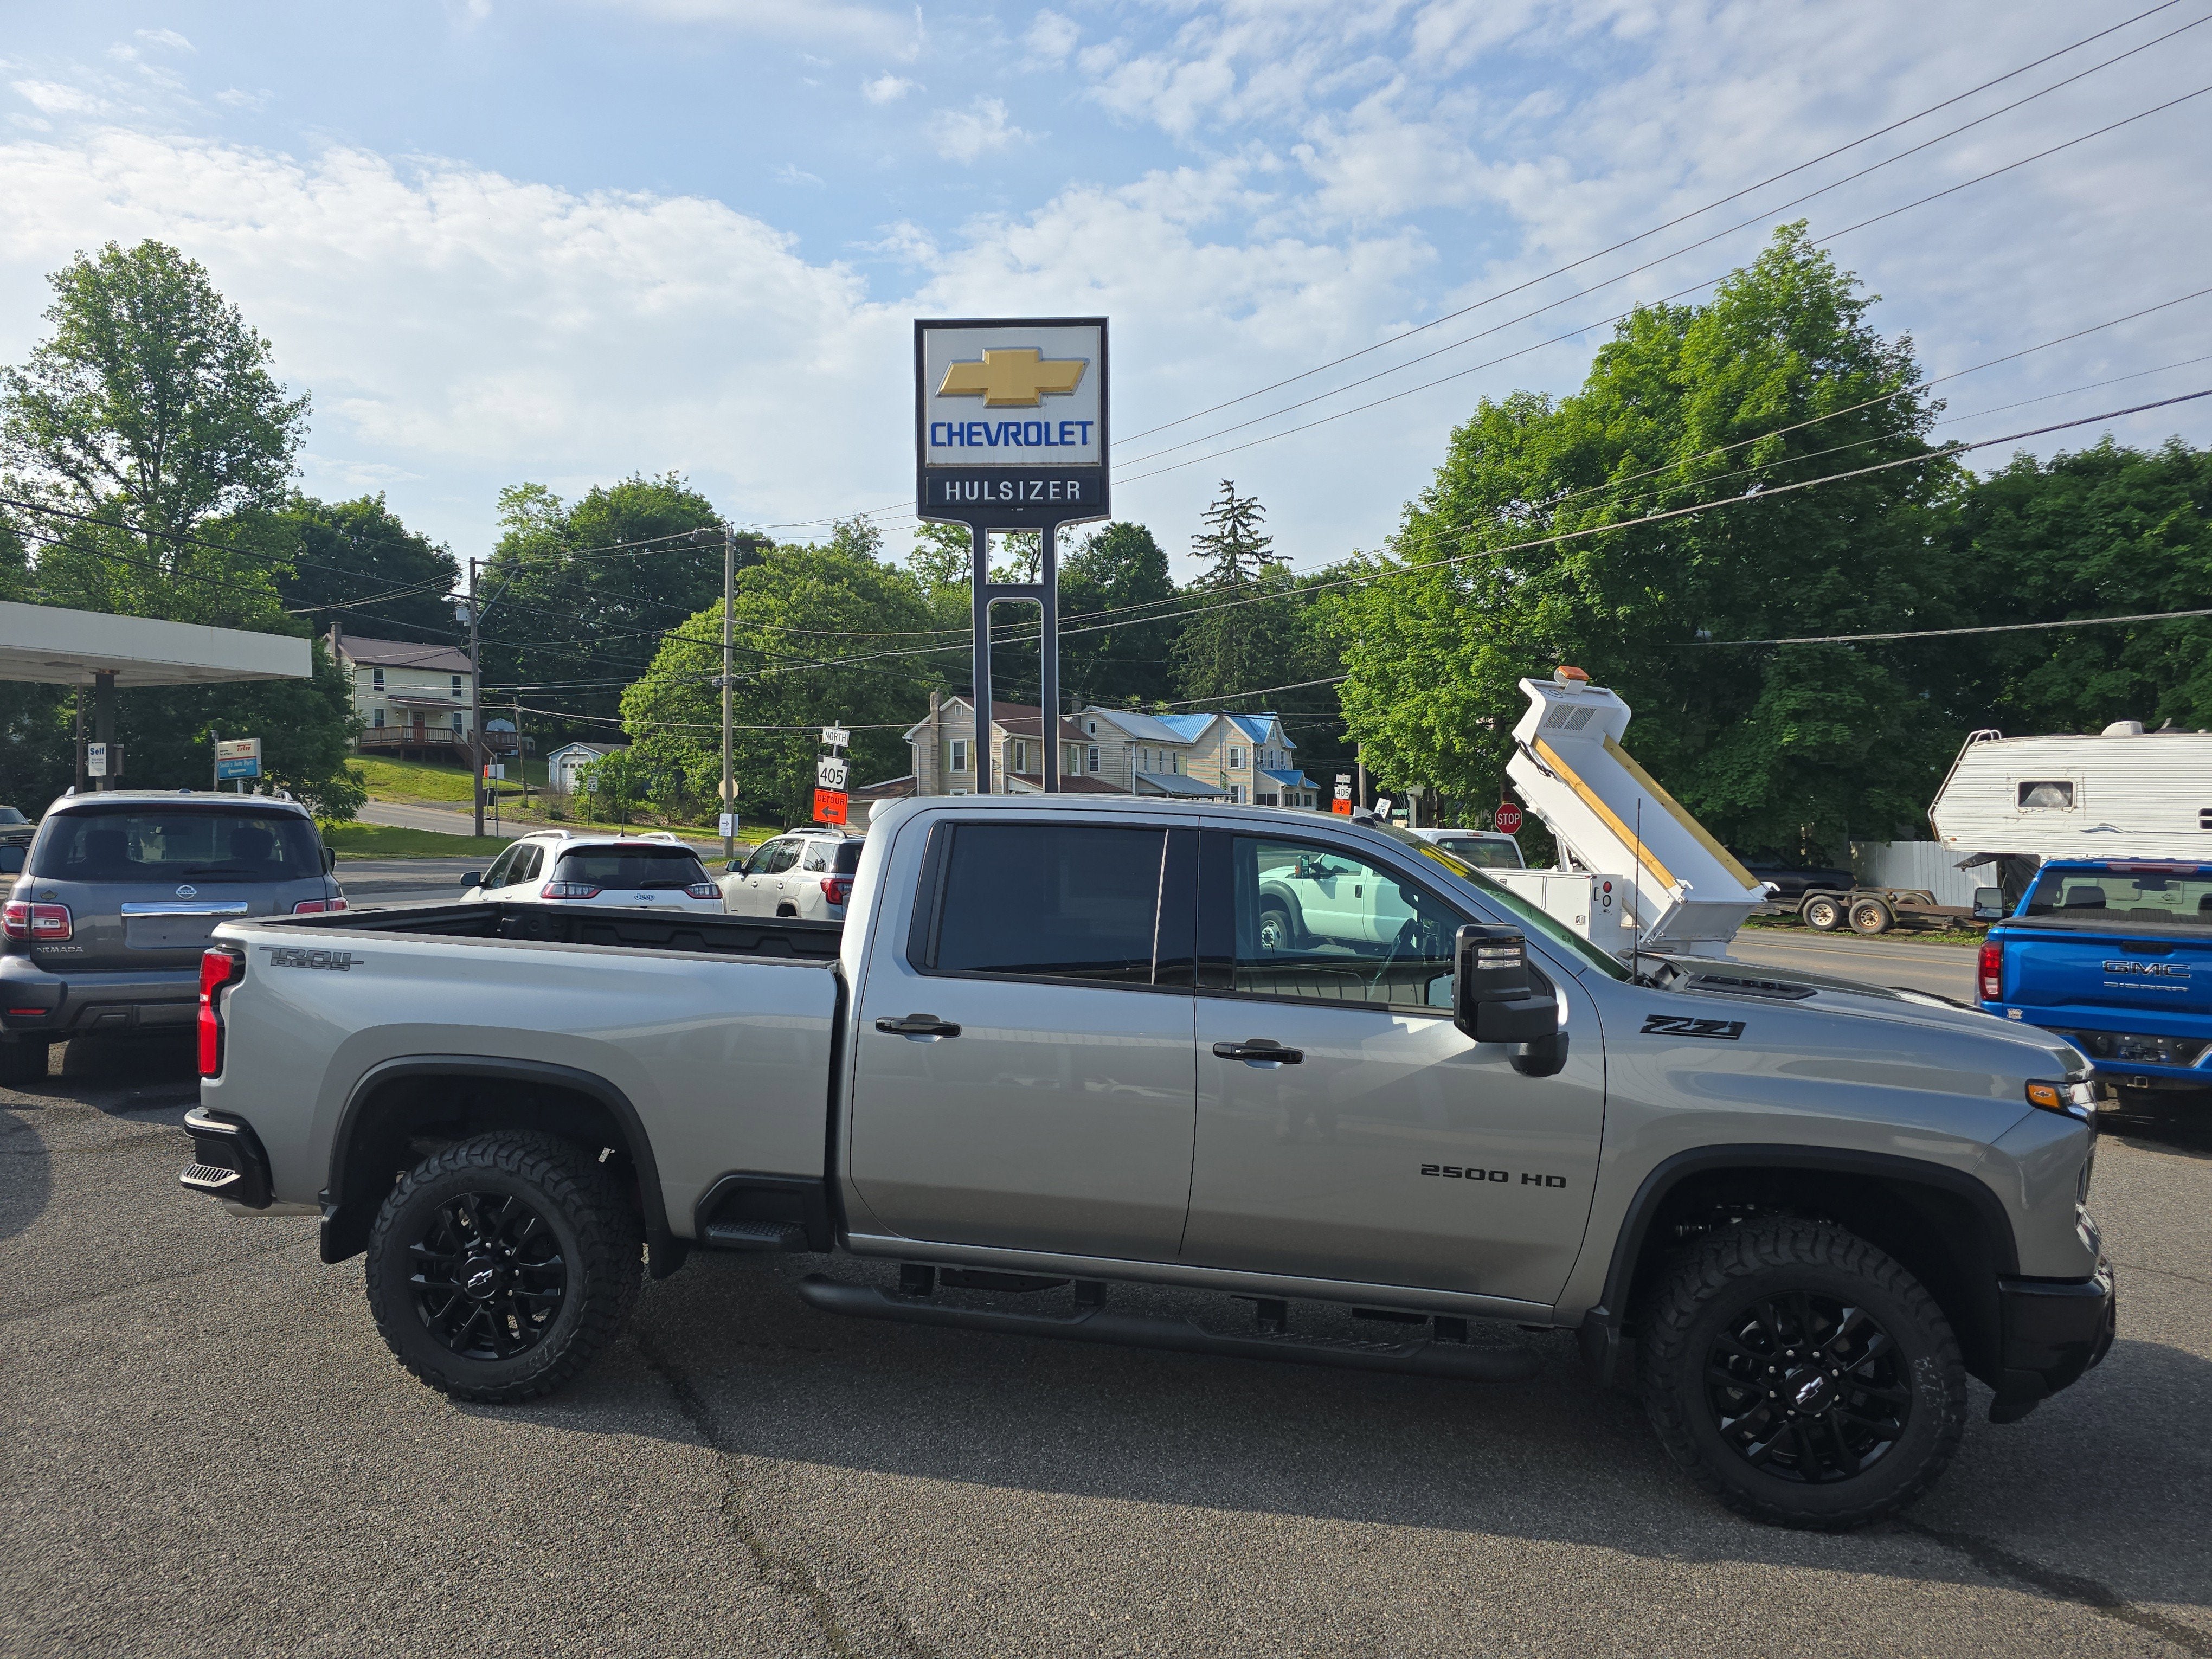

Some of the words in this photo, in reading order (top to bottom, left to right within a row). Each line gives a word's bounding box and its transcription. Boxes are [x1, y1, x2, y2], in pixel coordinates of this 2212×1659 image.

[931, 421, 1094, 447] CHEVROLET
[946, 480, 1081, 501] HULSIZER
[825, 731, 846, 742] NORTH
[90, 747, 105, 755] Self
[820, 767, 843, 785] 405
[817, 794, 845, 806] DETOUR
[1336, 789, 1349, 797] 405
[1497, 813, 1520, 825] STOP
[634, 892, 655, 901] Jeep
[259, 947, 364, 965] TRAIL
[271, 957, 350, 972] BOSS
[2102, 960, 2191, 978] GMC
[1639, 1014, 1747, 1040] Z71
[1421, 1163, 1509, 1183] 2500
[1521, 1173, 1566, 1188] HD
